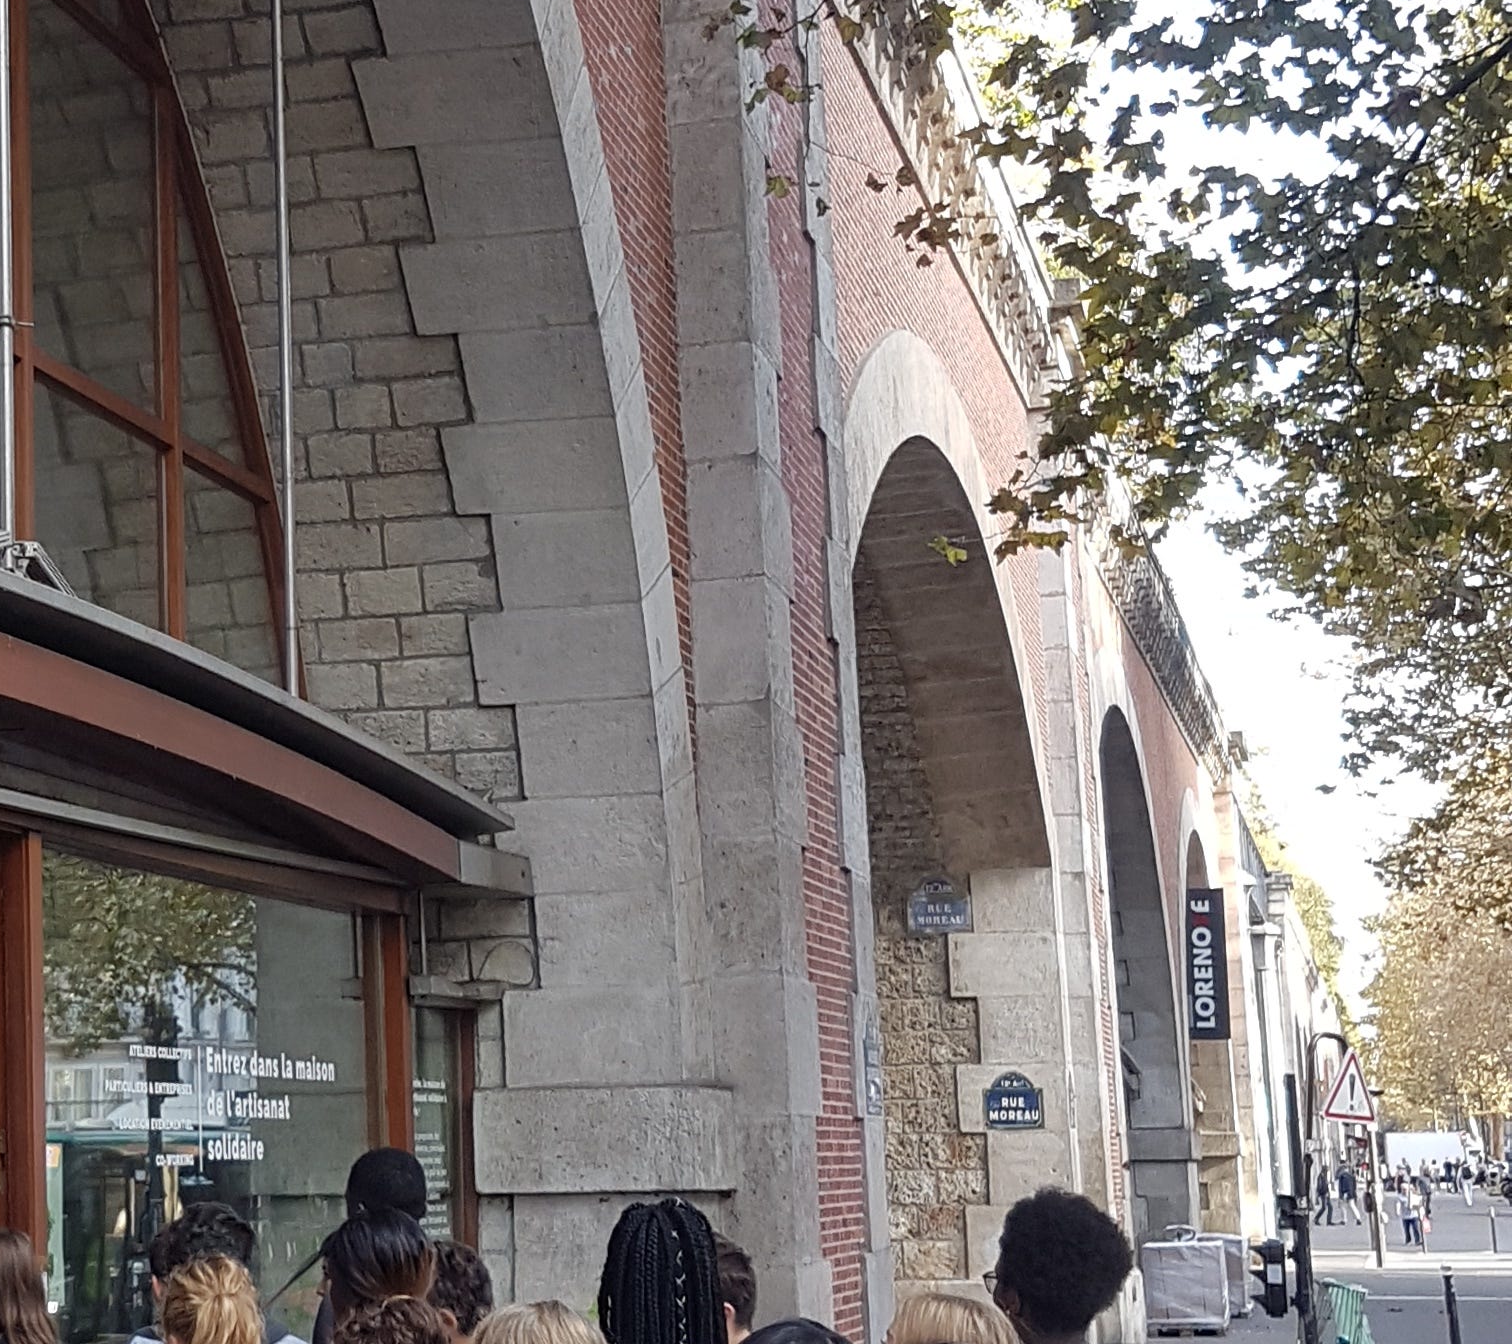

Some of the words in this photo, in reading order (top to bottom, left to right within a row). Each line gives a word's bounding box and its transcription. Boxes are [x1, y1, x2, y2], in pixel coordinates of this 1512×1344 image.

[927, 903, 952, 914] RUE
[917, 915, 965, 925] MOREAU
[129, 1045, 157, 1058] ATELIERS
[206, 1047, 247, 1075] Entrez
[250, 1049, 279, 1077] dans
[281, 1052, 293, 1079] la
[296, 1056, 335, 1082] maison
[104, 1079, 148, 1094] PARTICULIERS
[149, 1080, 155, 1094] &
[206, 1090, 224, 1117] de
[226, 1088, 291, 1120] l'artisanat
[1001, 1096, 1026, 1108] RUE
[989, 1109, 1039, 1121] MOREAU
[208, 1133, 264, 1161] solidaire
[155, 1154, 194, 1167] CO-WORKING
